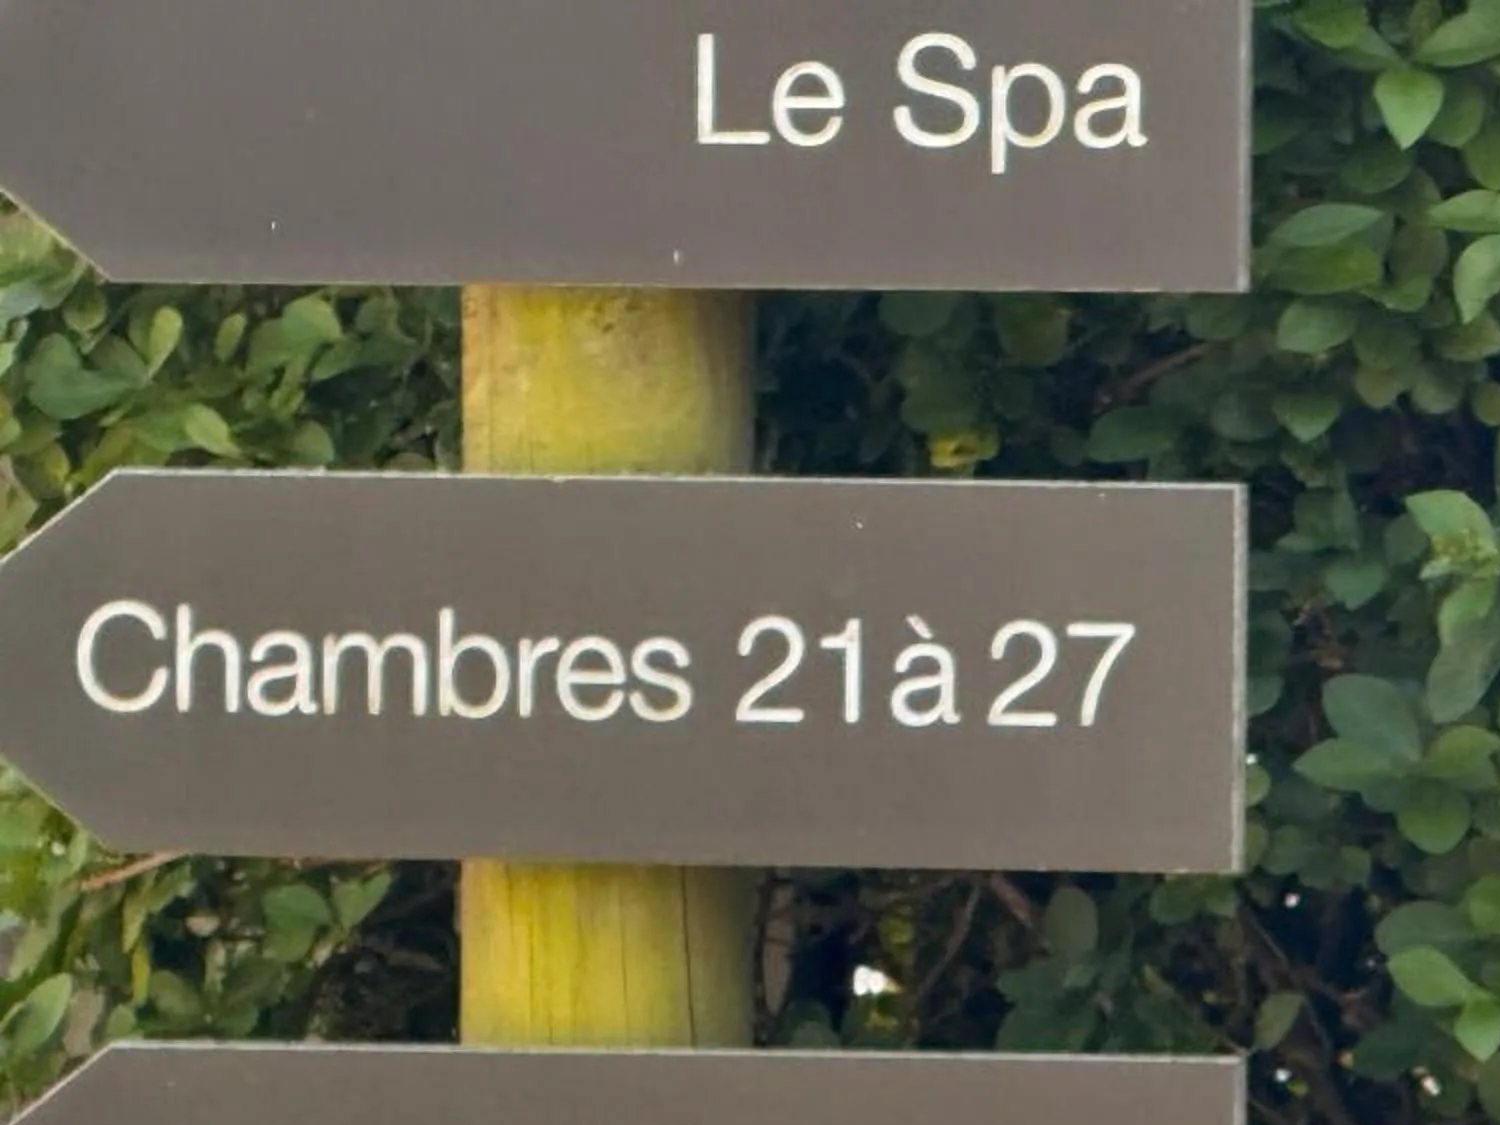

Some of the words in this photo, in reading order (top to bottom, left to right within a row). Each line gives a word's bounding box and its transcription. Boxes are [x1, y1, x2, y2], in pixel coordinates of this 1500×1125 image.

[695, 32, 847, 149] Le
[892, 31, 1150, 176] Spa
[75, 599, 694, 723] Chambres
[734, 614, 863, 726] 21
[889, 614, 962, 729] à
[986, 618, 1137, 730] 27
